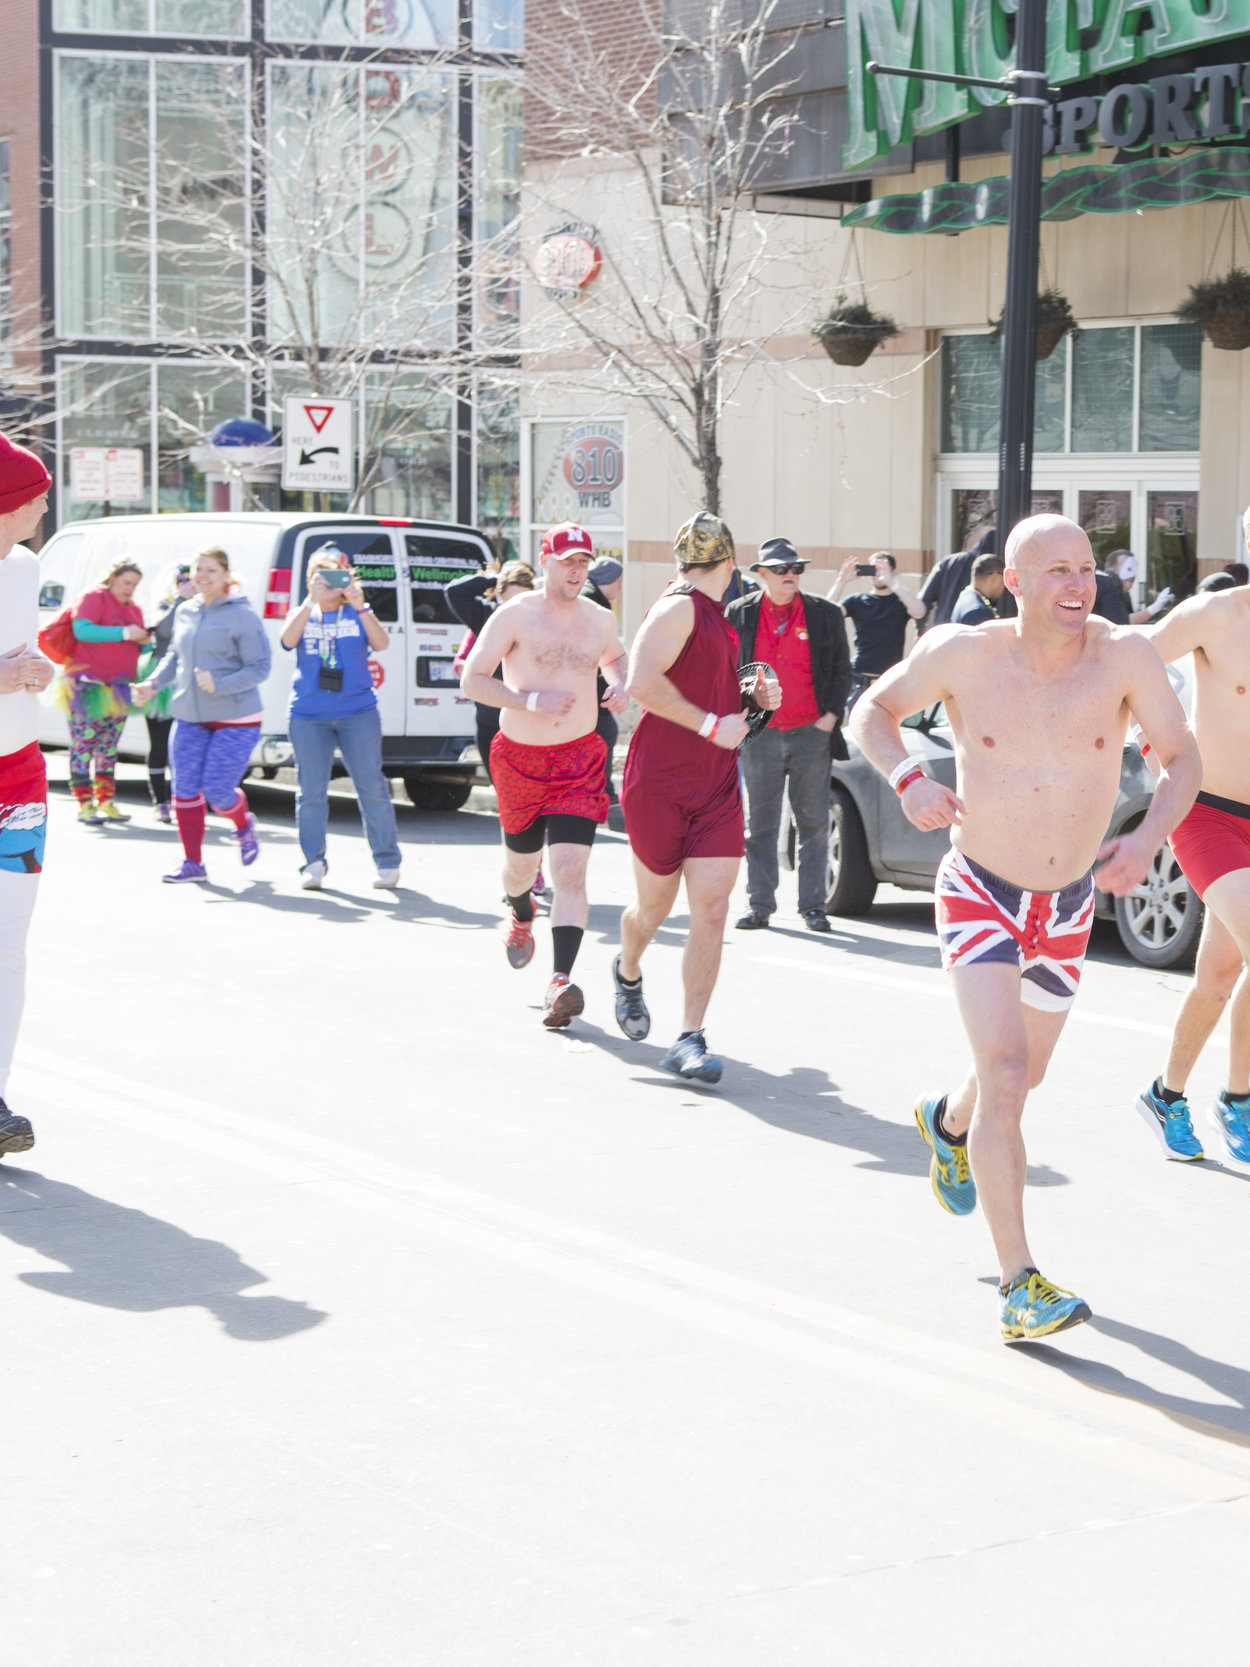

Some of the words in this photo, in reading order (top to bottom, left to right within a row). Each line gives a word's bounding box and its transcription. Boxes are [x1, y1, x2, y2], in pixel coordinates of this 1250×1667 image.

[291, 436, 313, 446] HERE
[329, 460, 340, 470] TO
[571, 446, 618, 486] 810
[289, 471, 348, 484] PEDESTRIANS
[578, 490, 612, 508] WHB
[566, 529, 584, 542] N
